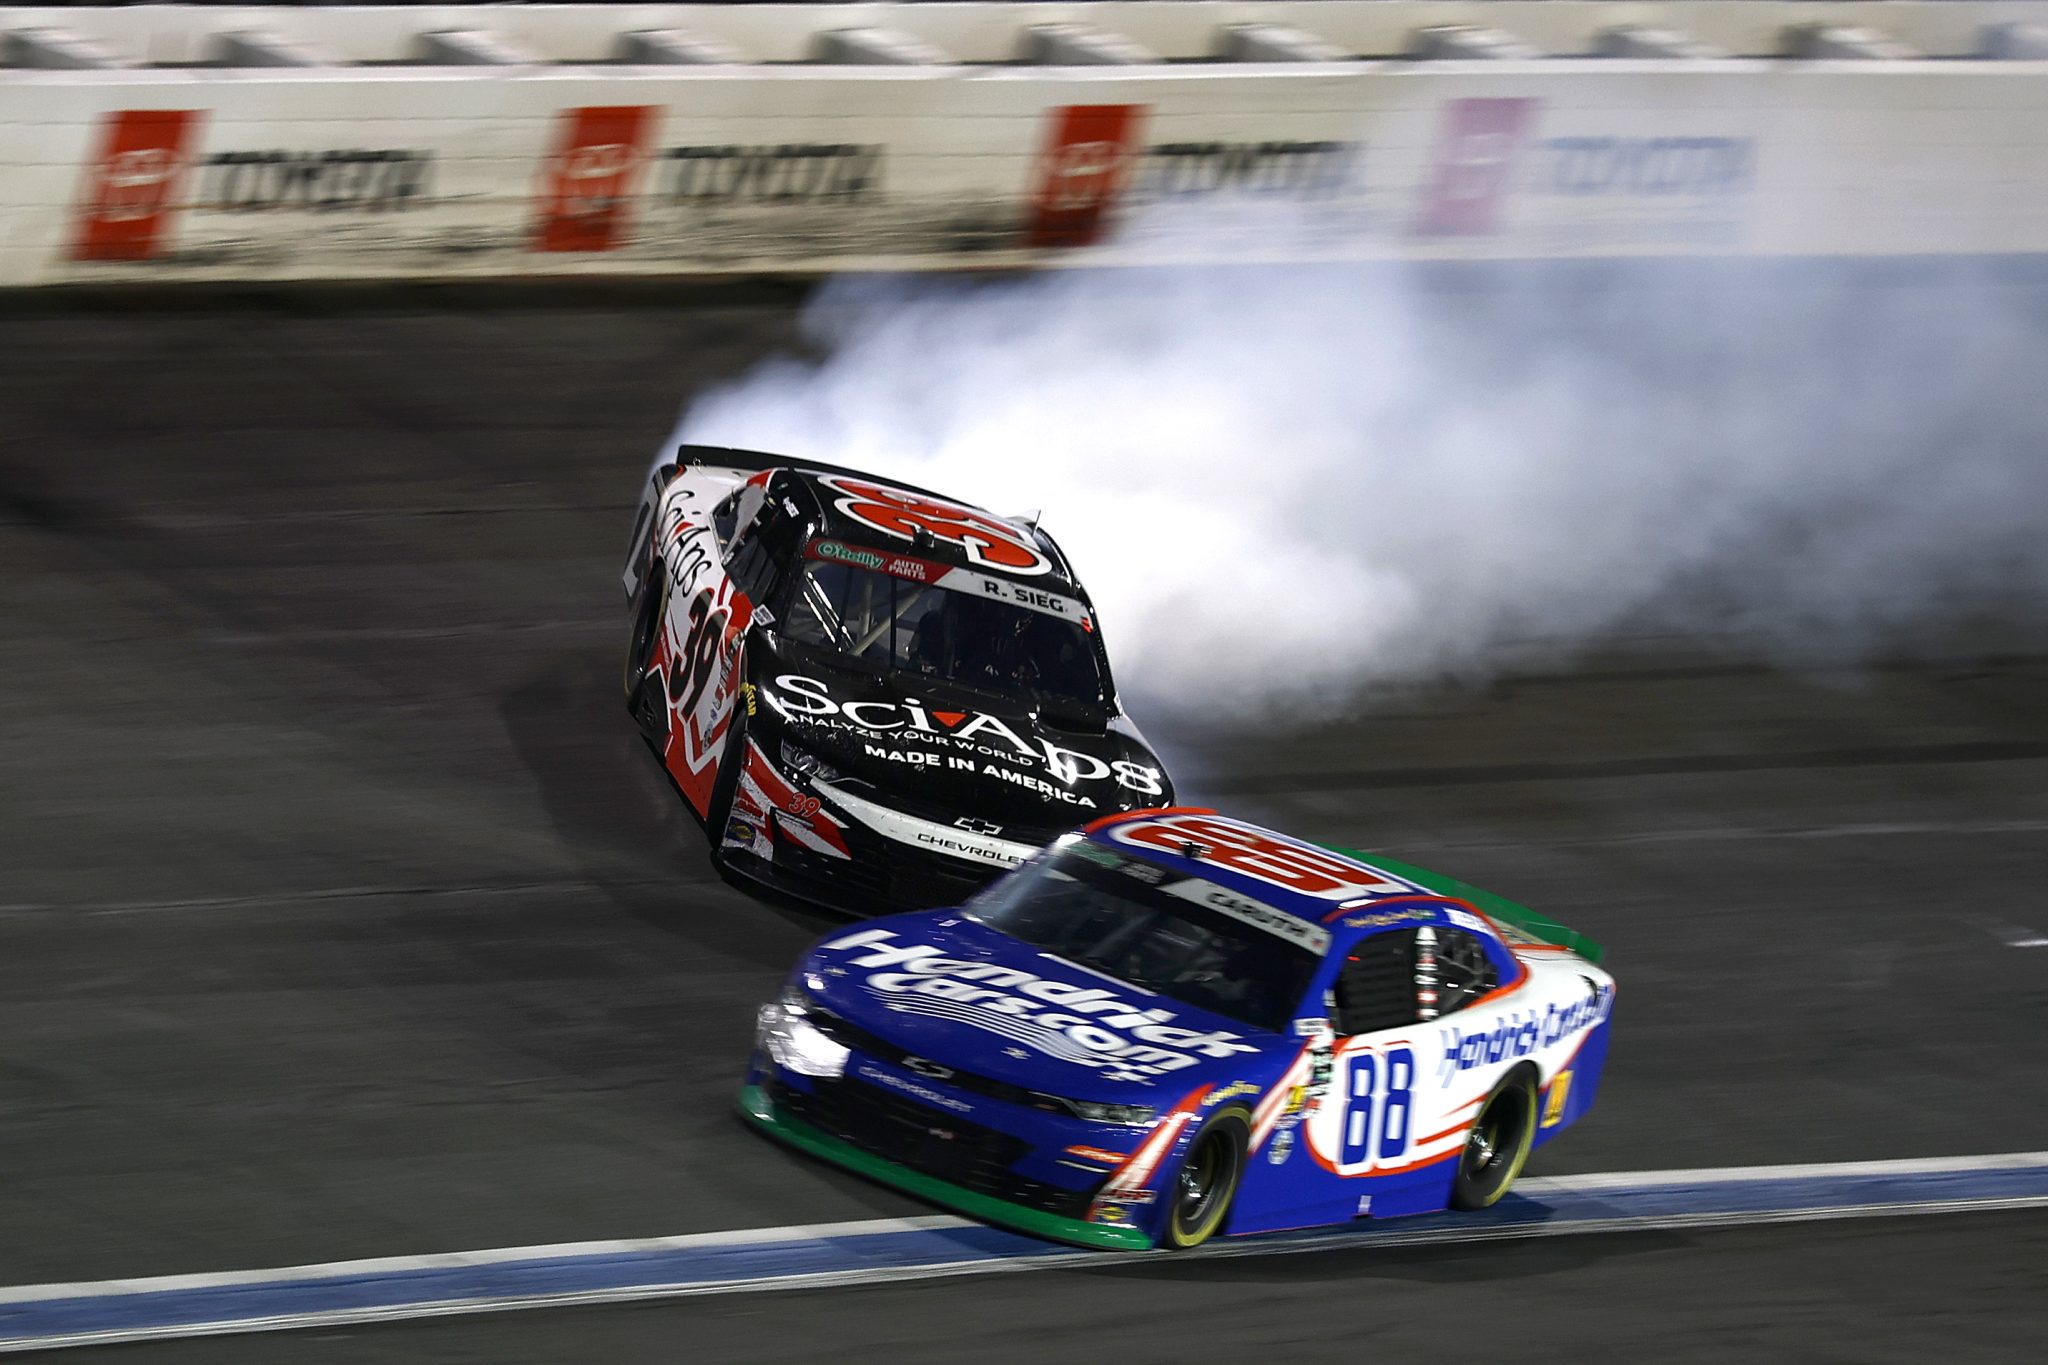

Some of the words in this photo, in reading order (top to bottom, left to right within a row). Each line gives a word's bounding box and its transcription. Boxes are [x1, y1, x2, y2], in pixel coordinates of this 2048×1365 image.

[816, 541, 888, 570] O'Reilly
[888, 564, 926, 580] PARTS
[893, 559, 924, 572] AUTO
[984, 580, 1008, 597] R.
[1014, 588, 1064, 613] SIEG
[668, 587, 730, 723] 39
[784, 713, 882, 739] ANALYZE
[888, 729, 949, 746] YOUR
[954, 740, 1034, 767] WORLD
[864, 744, 942, 767] MADE
[948, 756, 975, 771] IN
[982, 764, 1098, 809] AMERICA
[788, 792, 821, 818] 39
[818, 928, 1261, 1060] Hendrick
[1337, 1046, 1416, 1168] 88
